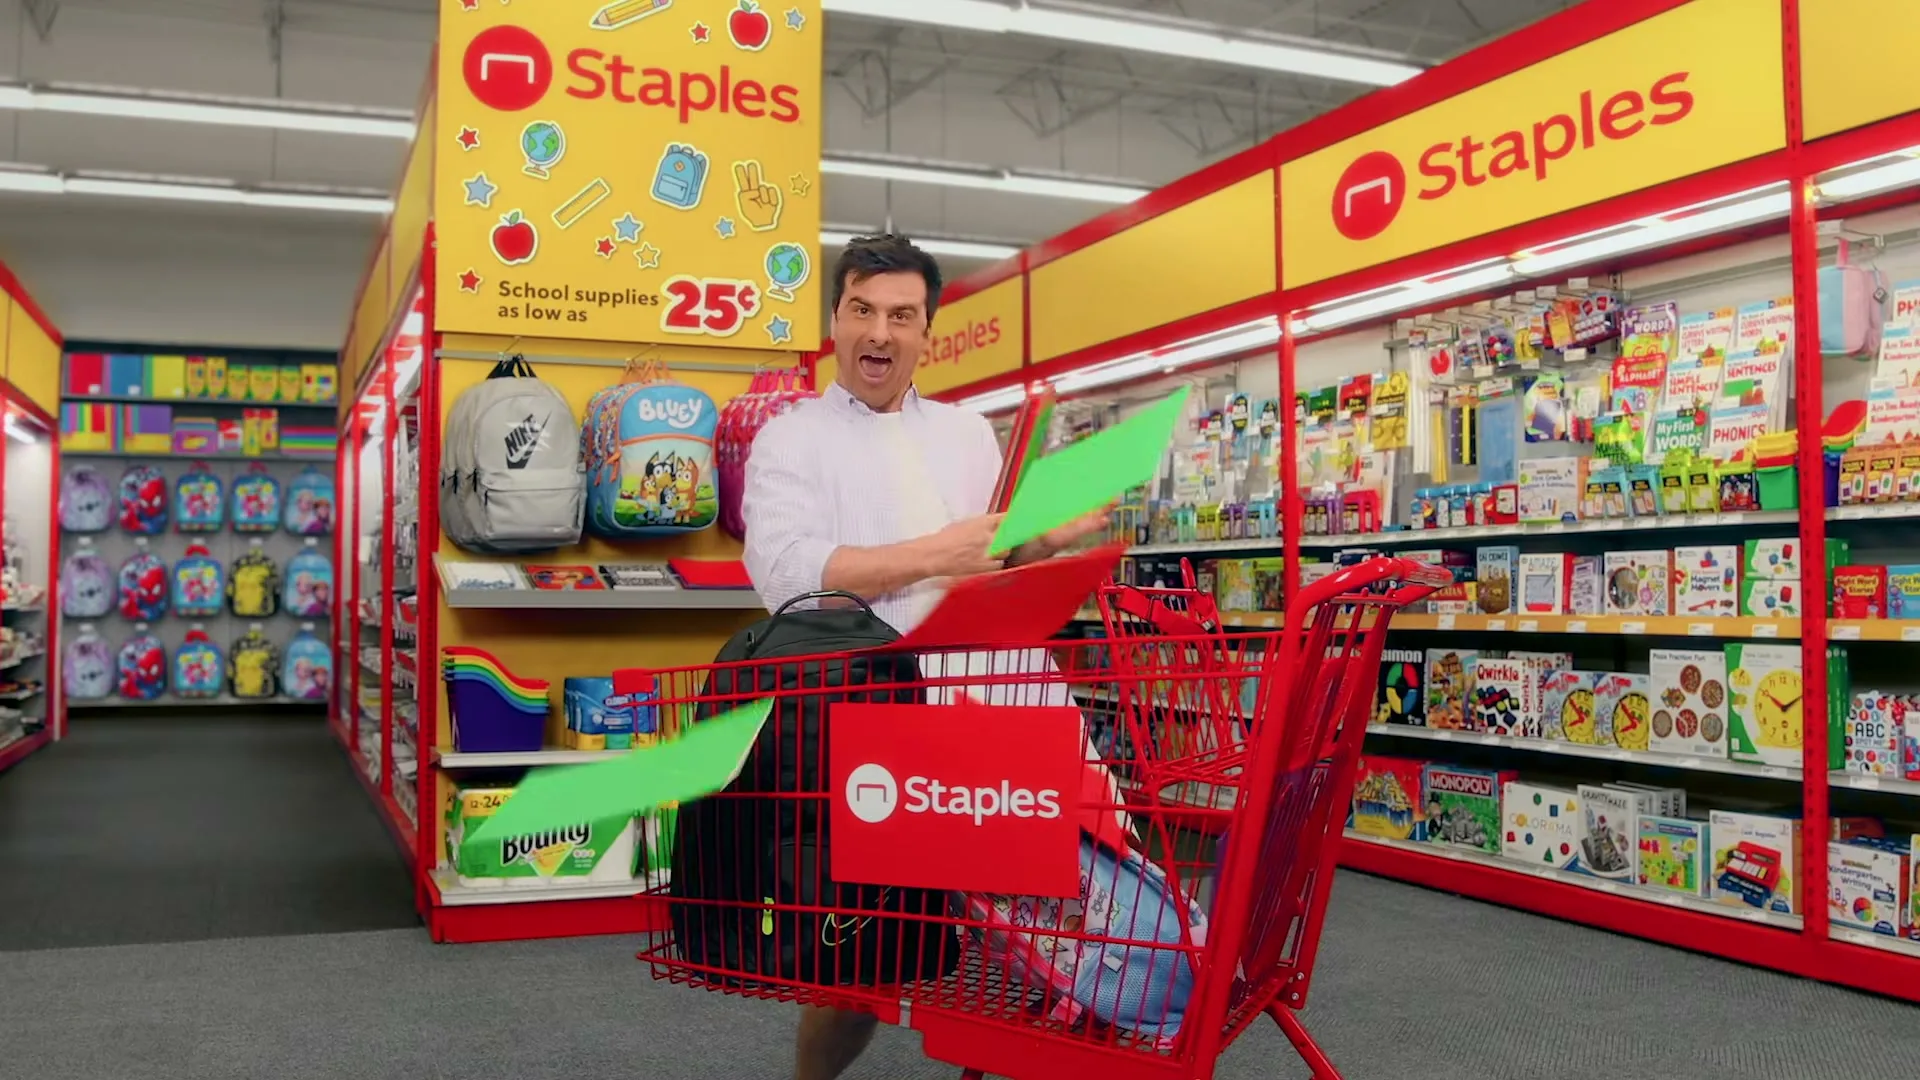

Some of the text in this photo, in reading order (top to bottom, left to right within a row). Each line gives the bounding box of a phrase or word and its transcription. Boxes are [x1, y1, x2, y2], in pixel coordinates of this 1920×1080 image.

[565, 48, 801, 124] Staples
[1416, 71, 1695, 182] Staples
[498, 281, 570, 302] School
[575, 288, 659, 309] supplies
[498, 304, 588, 322] as low as
[1727, 361, 1777, 378] SENTENCES
[638, 398, 702, 429] BLUEY
[1656, 419, 1695, 435] My First
[1713, 424, 1766, 443] PHONICS
[1656, 432, 1703, 450] WORDS
[1691, 574, 1720, 585] Magnet
[1382, 650, 1422, 663] simon
[1477, 664, 1519, 681] Qwirkle
[1855, 722, 1885, 738] ABC
[1430, 773, 1492, 794] MONOPOLY
[903, 775, 1062, 826] Staples
